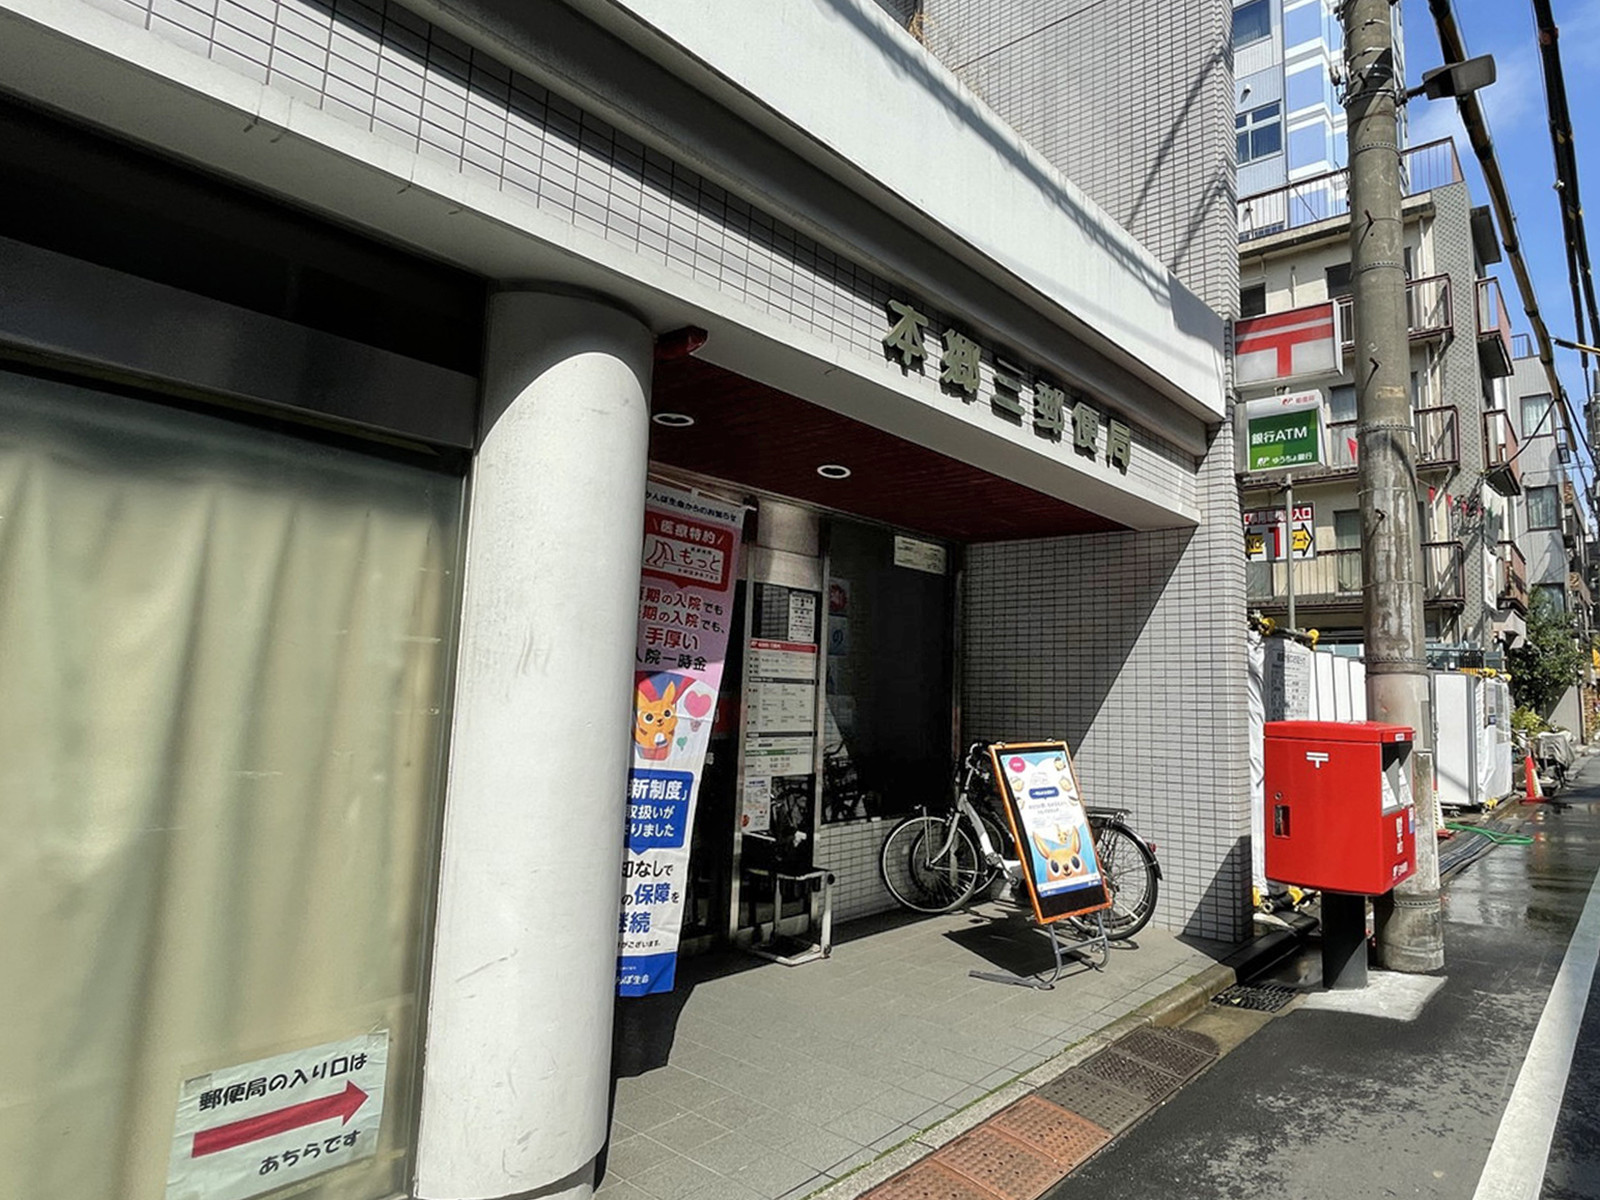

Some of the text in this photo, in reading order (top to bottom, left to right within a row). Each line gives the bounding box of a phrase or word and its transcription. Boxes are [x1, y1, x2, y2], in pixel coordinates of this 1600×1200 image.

[882, 299, 1131, 470] 本郷三郵便局
[1251, 426, 1308, 445] 銀行ATM
[679, 548, 720, 573] もっと
[638, 604, 725, 634] 期の入院でも、
[645, 626, 698, 650] 手厚い
[198, 1052, 368, 1112] 郵便局の入り口は
[258, 1129, 361, 1176] あちらです
